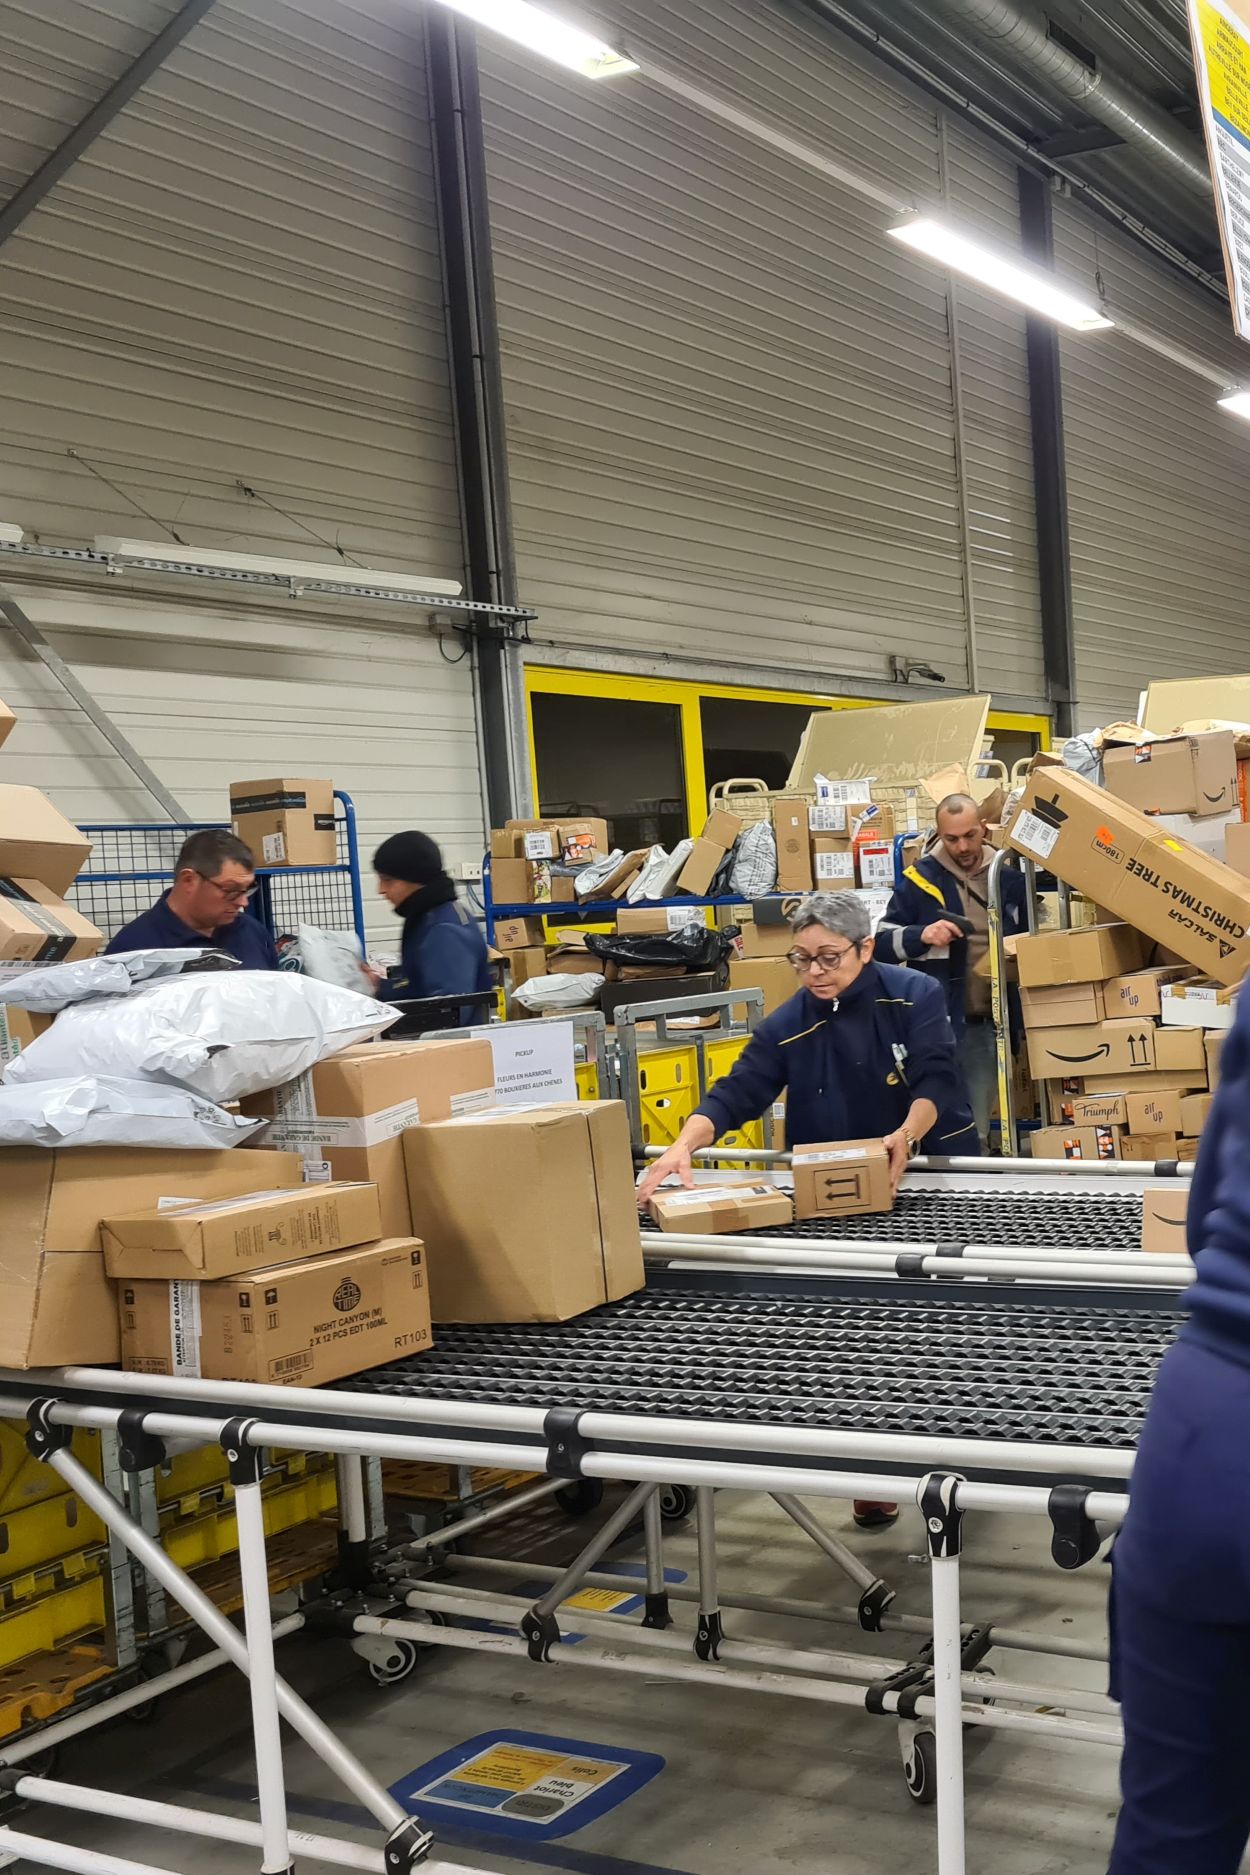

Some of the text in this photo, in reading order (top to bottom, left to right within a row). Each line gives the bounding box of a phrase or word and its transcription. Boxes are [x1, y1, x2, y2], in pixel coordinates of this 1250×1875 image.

[1126, 857, 1245, 939] CHRISTMAS TREE
[1168, 908, 1217, 943] SALCAR
[1120, 986, 1131, 999] air
[1128, 994, 1139, 1006] up
[514, 1049, 534, 1057] PICKUP
[497, 1069, 552, 1083] FLEURS EN HARMONIE
[504, 1084, 532, 1093] BOUXIERES
[544, 1078, 563, 1087] CHENES
[1075, 1100, 1120, 1121] Triumph
[1144, 1102, 1155, 1115] air
[1152, 1110, 1163, 1123] up
[336, 1284, 361, 1300] REAL
[336, 1296, 361, 1311] TIME
[174, 1317, 181, 1331] DE
[313, 1307, 383, 1334] NIGHT CANYON (M)
[309, 1317, 389, 1347] 2 X 12 PCS EDT 100ML
[394, 1328, 428, 1349] RT103
[175, 1332, 183, 1366] BANDE
[548, 1778, 575, 1789] bleu
[533, 1785, 575, 1798] Chariot
